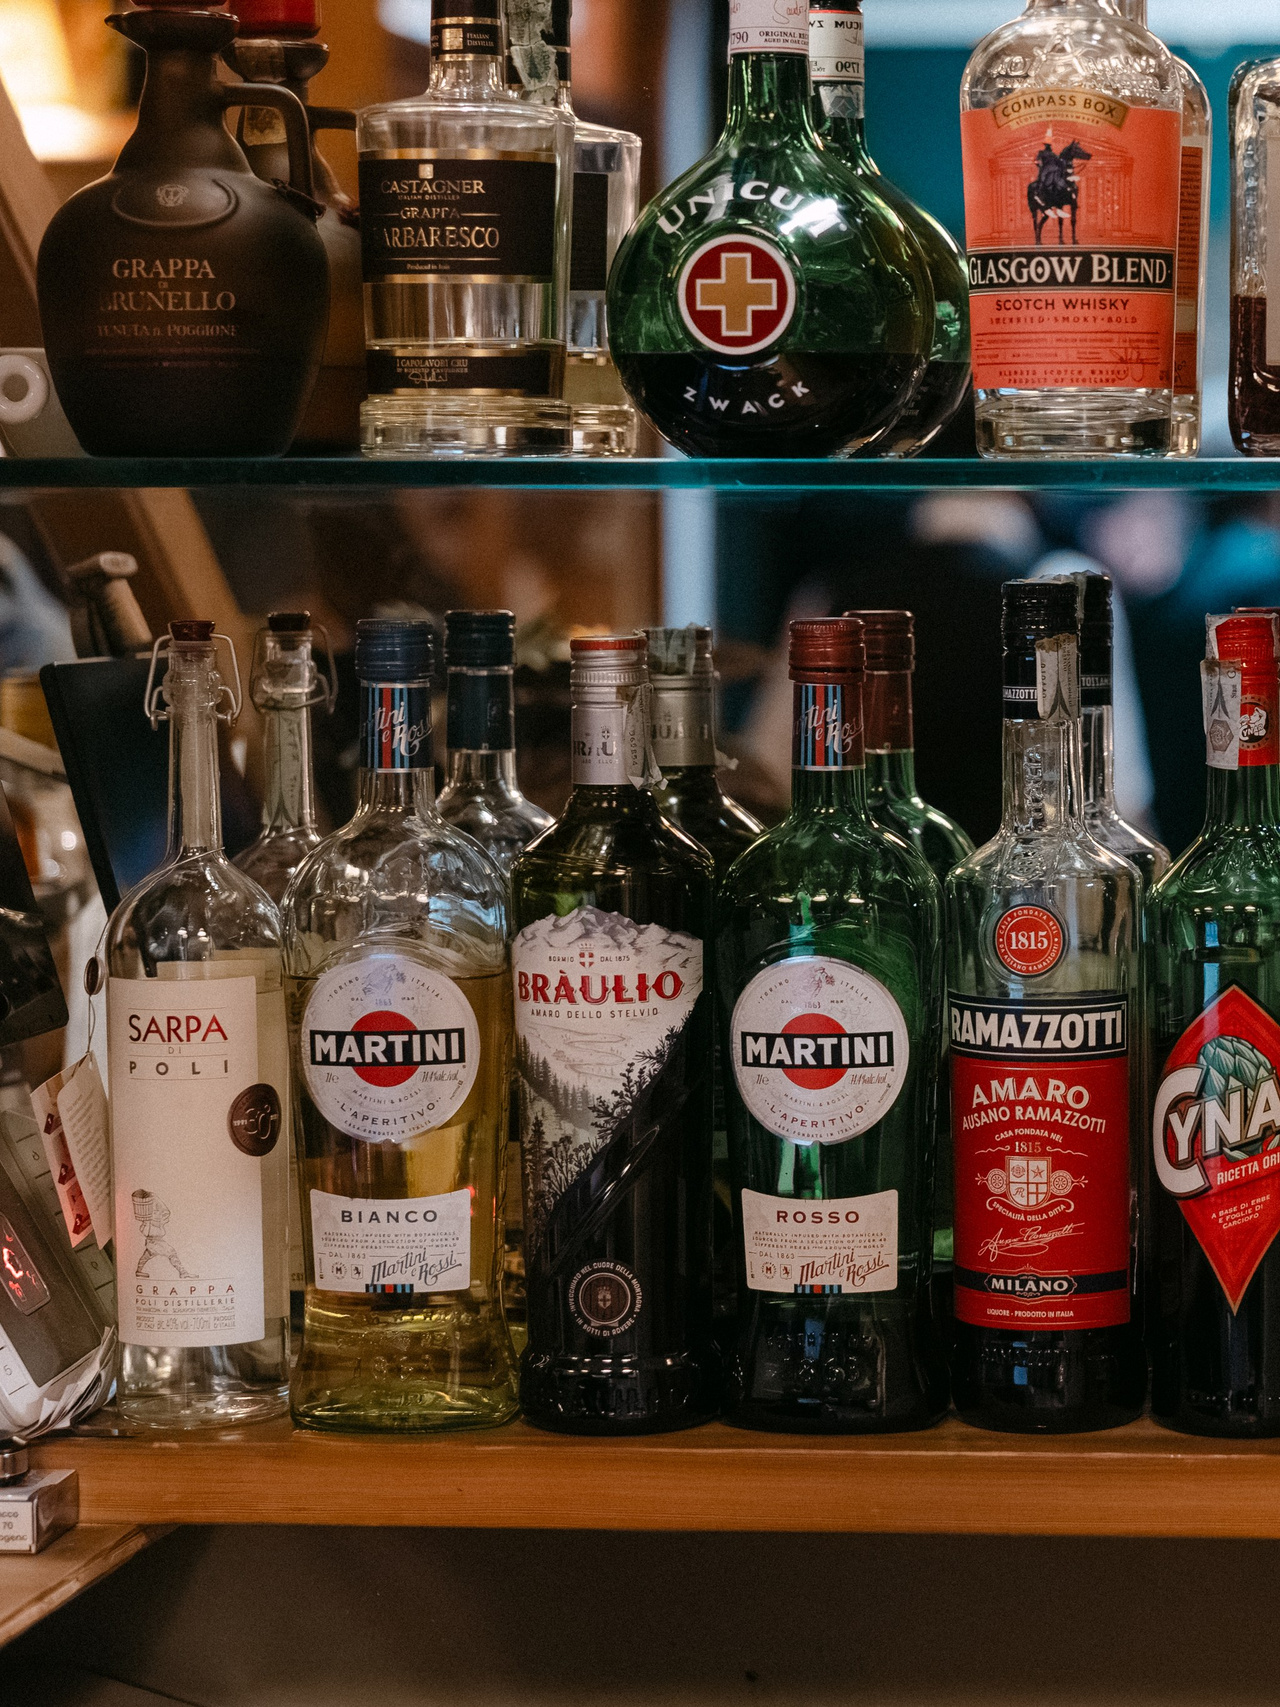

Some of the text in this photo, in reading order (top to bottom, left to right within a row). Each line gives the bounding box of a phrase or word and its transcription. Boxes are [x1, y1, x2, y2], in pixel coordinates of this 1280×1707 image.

[758, 30, 797, 39] ORIGINAL
[1001, 94, 1117, 118] COMPASS BOX
[381, 179, 486, 194] CASTAGNER
[112, 258, 217, 279] GRAPPA
[968, 253, 1167, 286] GLASGOW BLEND
[995, 298, 1130, 312] SCOTCH WHISKY
[682, 381, 810, 415] ZWACK
[1009, 930, 1049, 950] 1815
[600, 955, 613, 963] DAL
[517, 969, 685, 1006] BRÀULIO
[531, 1007, 659, 1019] AMARO DELLO STELVIO
[128, 1013, 229, 1043] SARPA
[950, 1006, 1123, 1050] RAMAZZOTTI
[167, 1046, 182, 1055] DI
[313, 1031, 461, 1064] MARTINI
[745, 1034, 889, 1066] MARTINI
[129, 1059, 229, 1076] POLI
[971, 1076, 1092, 1110] AMARO
[339, 1101, 437, 1126] L'APERITIVO
[769, 1104, 864, 1129] L'APERITIVO
[962, 1105, 1107, 1134] AUSANO RAMAZZOTTI
[994, 1128, 1064, 1143] CASA FONDATA NEL
[1014, 1141, 1042, 1153] 1815
[1216, 1160, 1260, 1186] RICETTA
[340, 1209, 439, 1224] BIANCO
[776, 1210, 860, 1224] ROSSO
[992, 1201, 1066, 1222] SPECIALITÀ DELLA DITTA
[1218, 1205, 1238, 1217] BASE
[1225, 1208, 1253, 1222] FOGLIE
[1222, 1212, 1260, 1230] CARCIOFO
[347, 1252, 367, 1260] 1863
[776, 1252, 796, 1260] 1863
[370, 1246, 428, 1288] Martini
[418, 1250, 463, 1287] Rossi
[592, 1261, 615, 1270] CUORE
[615, 1264, 634, 1280] DELLA
[799, 1247, 855, 1287] Martini
[845, 1251, 890, 1288] Rossi
[135, 1284, 235, 1296] GRAPPA
[991, 1277, 1069, 1292] MILANO
[135, 1297, 235, 1307] POLI DISTILLERIE
[986, 1308, 1010, 1317] LIQUORE
[1014, 1310, 1047, 1318] PRODOTTO
[1055, 1310, 1074, 1318] ITALIA
[582, 1323, 601, 1336] BOTTI
